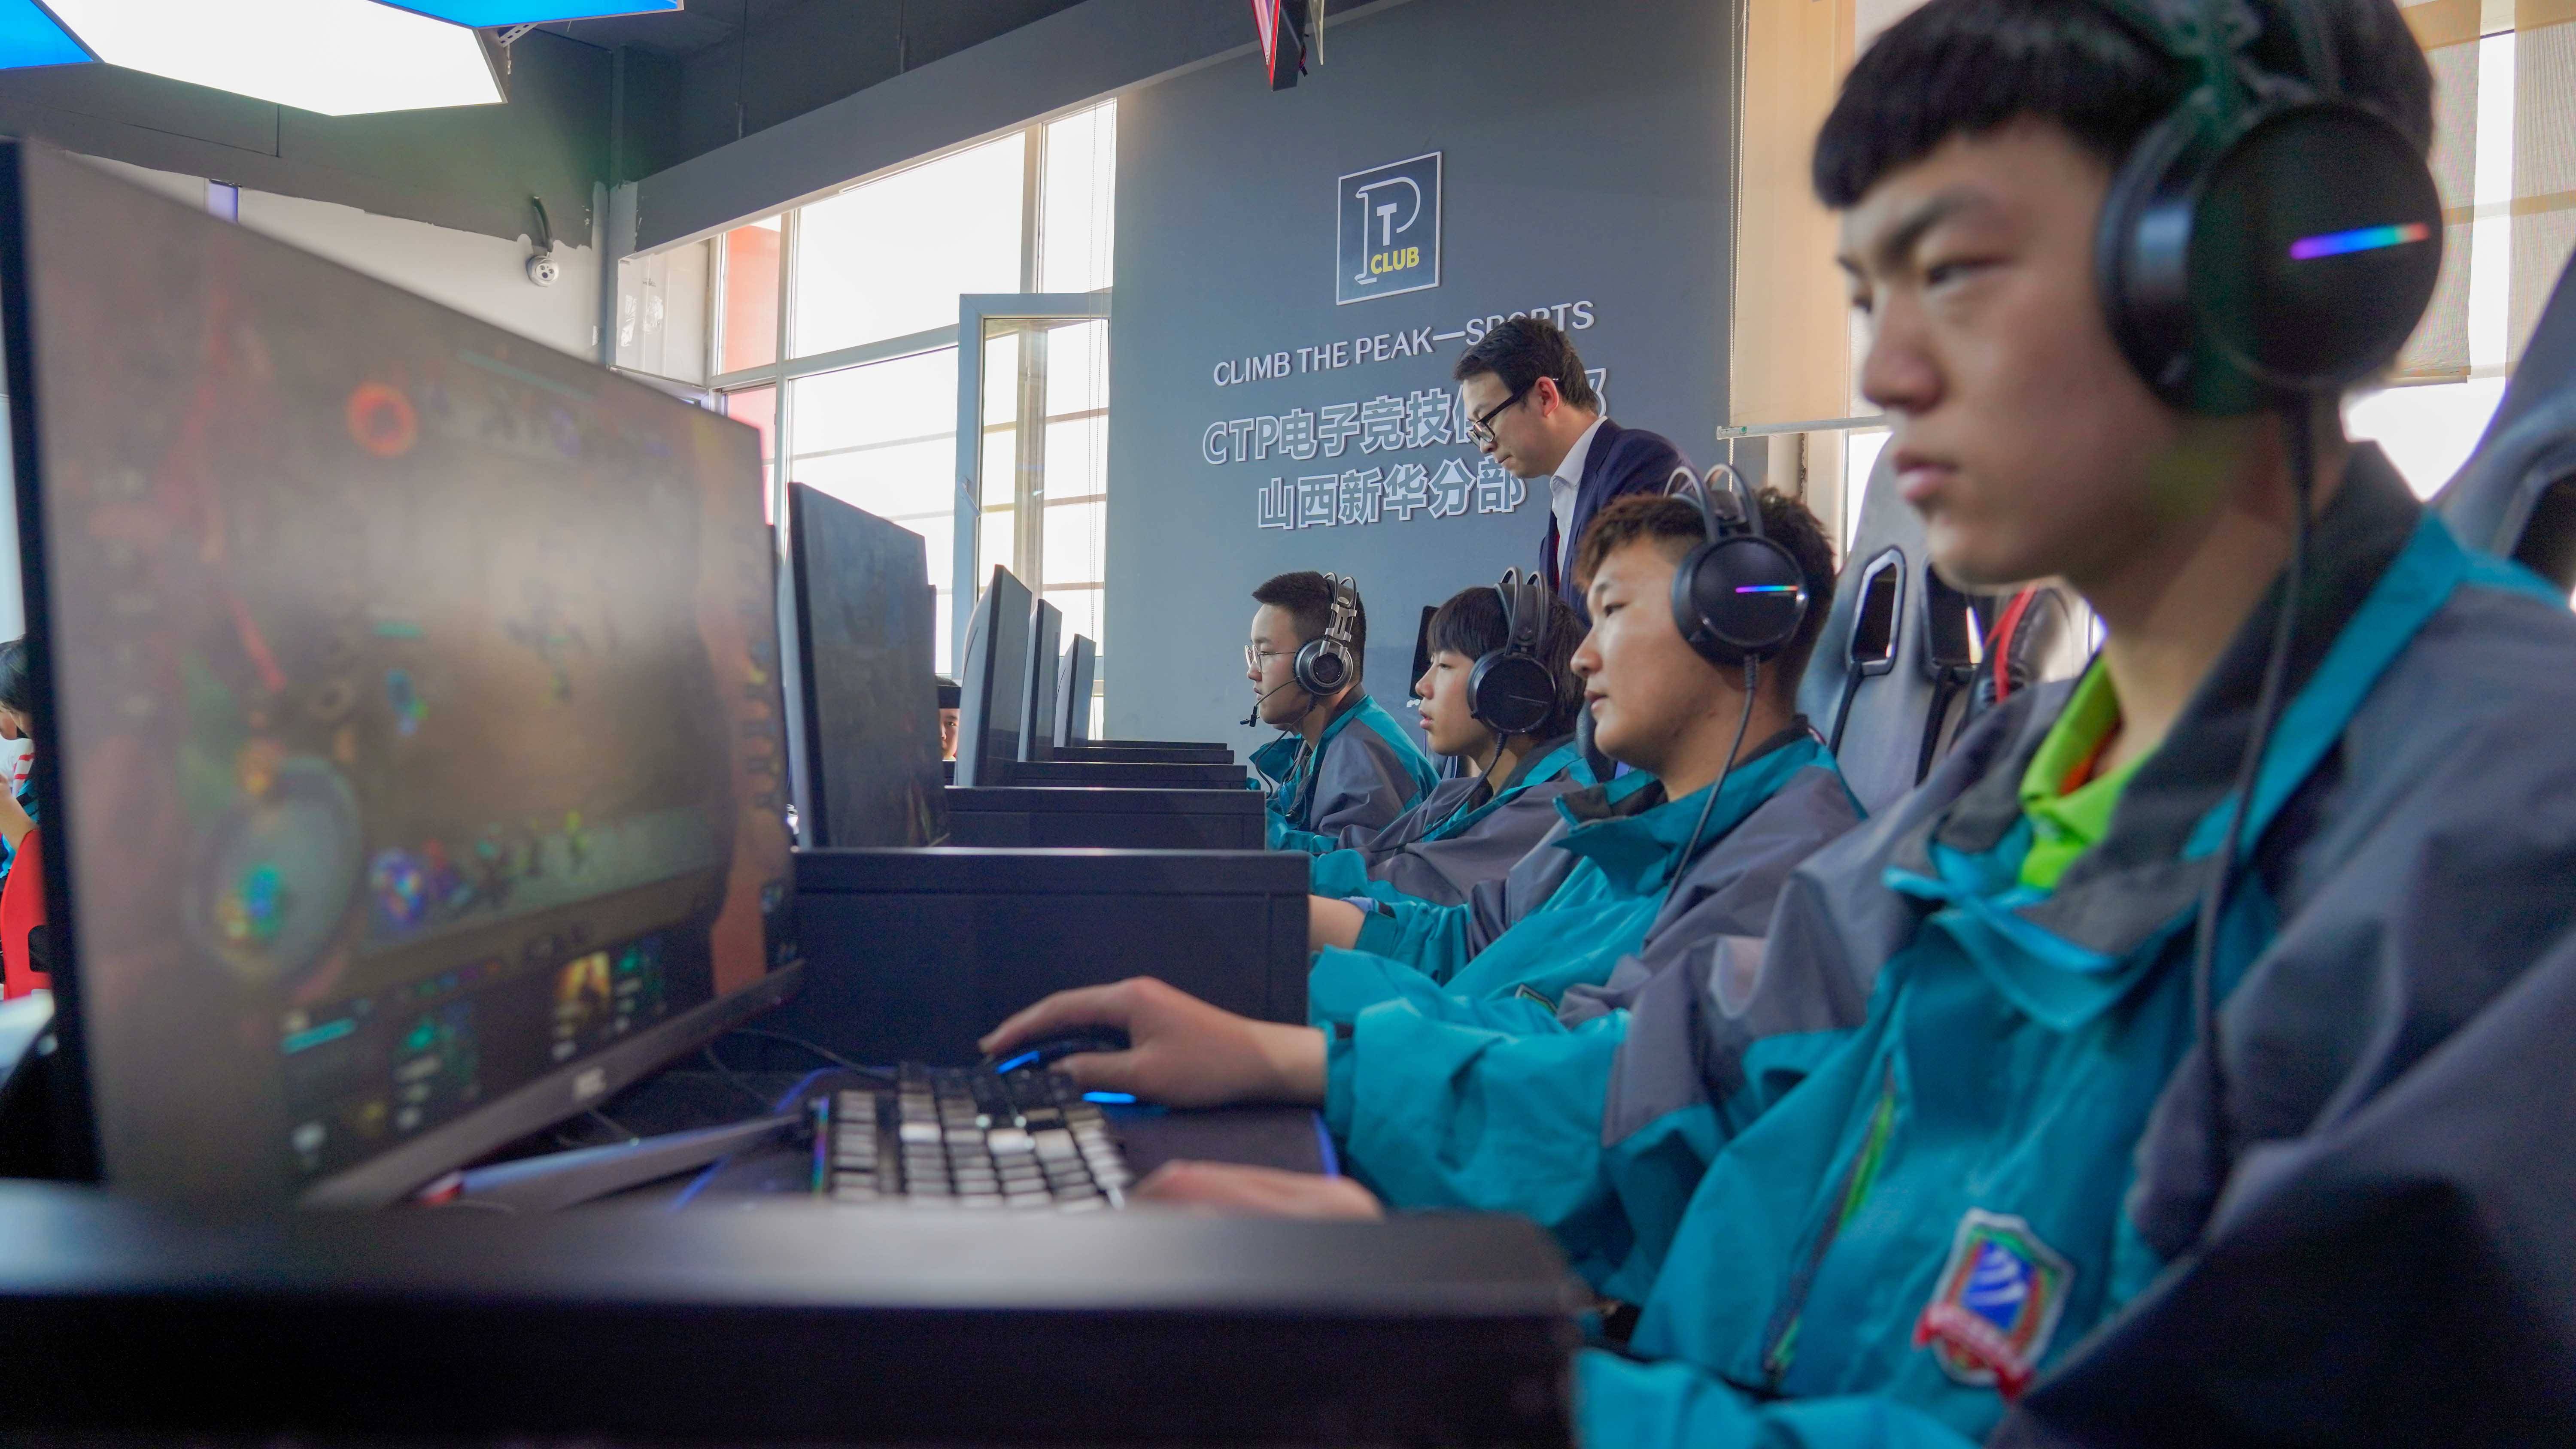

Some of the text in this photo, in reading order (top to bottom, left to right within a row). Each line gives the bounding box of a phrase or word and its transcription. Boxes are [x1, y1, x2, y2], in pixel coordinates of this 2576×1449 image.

[1370, 247, 1419, 275] CLUB
[1213, 352, 1291, 386] CLIMB
[1297, 341, 1349, 373] THE
[1203, 368, 1606, 465] CTP电子竞技
[1258, 455, 1526, 530] 山西新华分部
